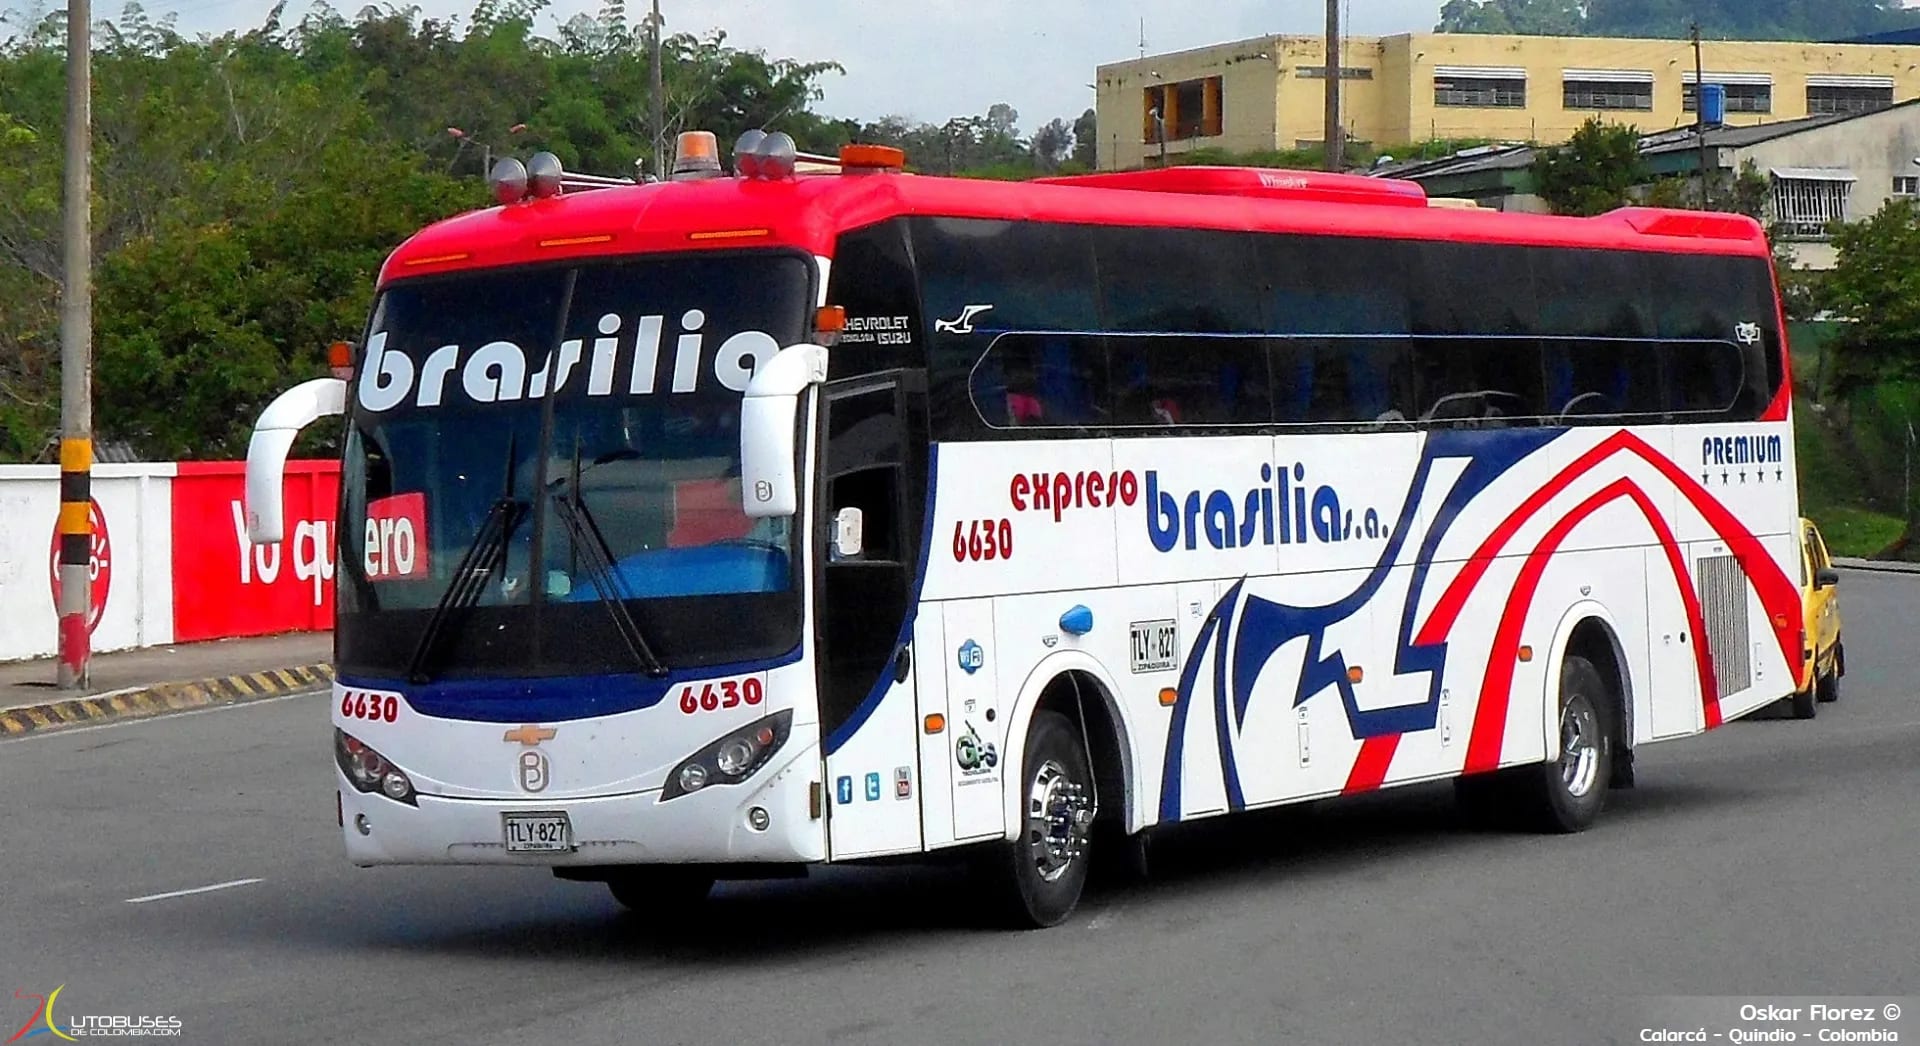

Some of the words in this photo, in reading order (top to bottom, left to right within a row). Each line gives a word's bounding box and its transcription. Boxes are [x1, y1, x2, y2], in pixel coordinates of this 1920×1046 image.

[843, 315, 909, 331] HEVROLET
[877, 331, 912, 345] ISUZU
[359, 309, 781, 412] brasilia
[1702, 434, 1782, 465] PREMIUM
[1010, 469, 1138, 523] expreso
[1145, 461, 1342, 553] brasilia
[952, 517, 1014, 563] 6630
[341, 691, 399, 724] 6630
[679, 676, 764, 716] 6630
